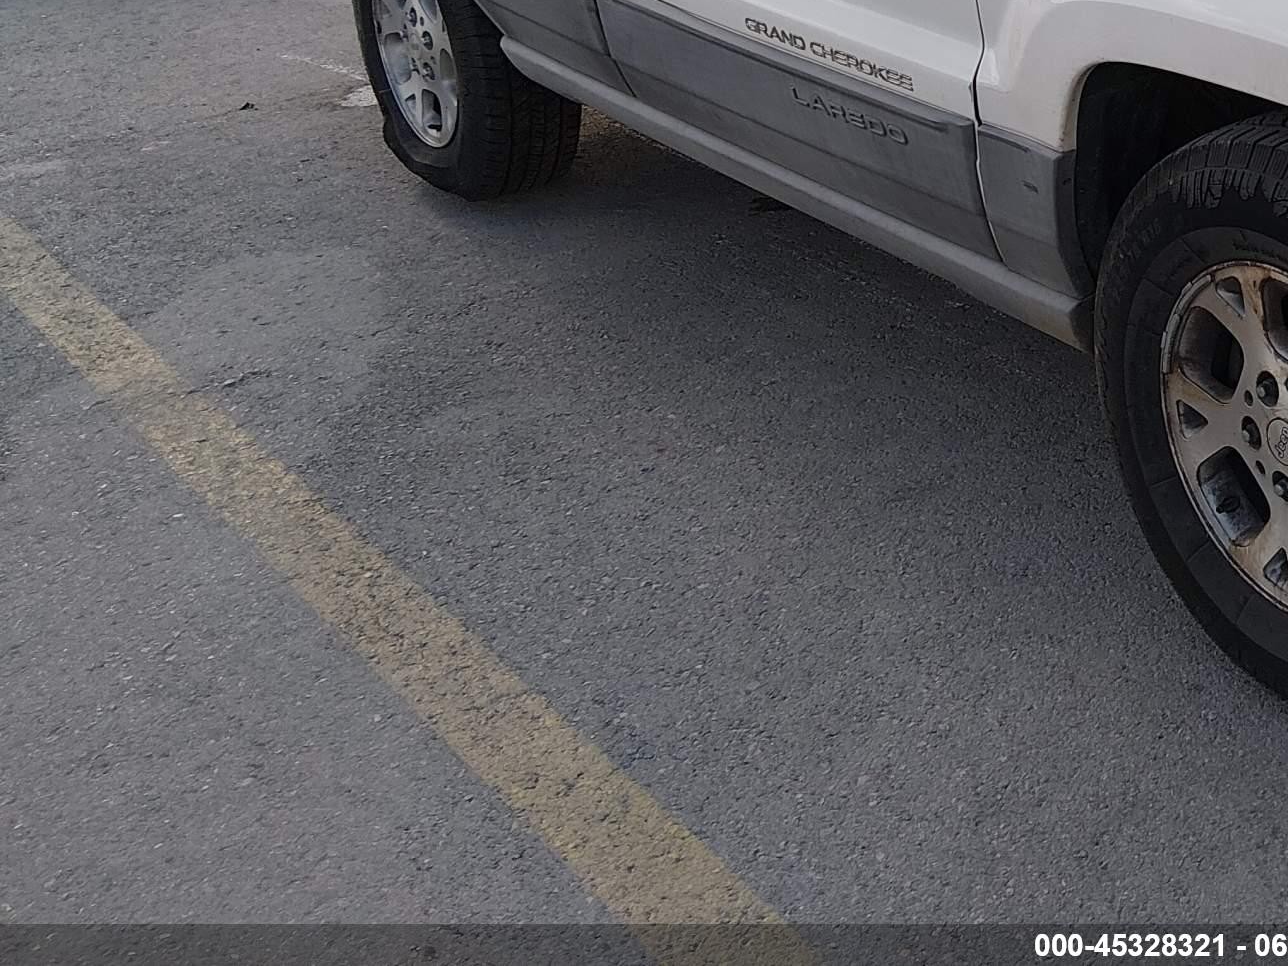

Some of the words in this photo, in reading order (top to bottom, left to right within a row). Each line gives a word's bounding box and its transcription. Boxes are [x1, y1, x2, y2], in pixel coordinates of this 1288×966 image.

[744, 17, 807, 51] GRAND
[809, 41, 915, 92] CHEROKEE
[789, 85, 909, 146] LAREDO
